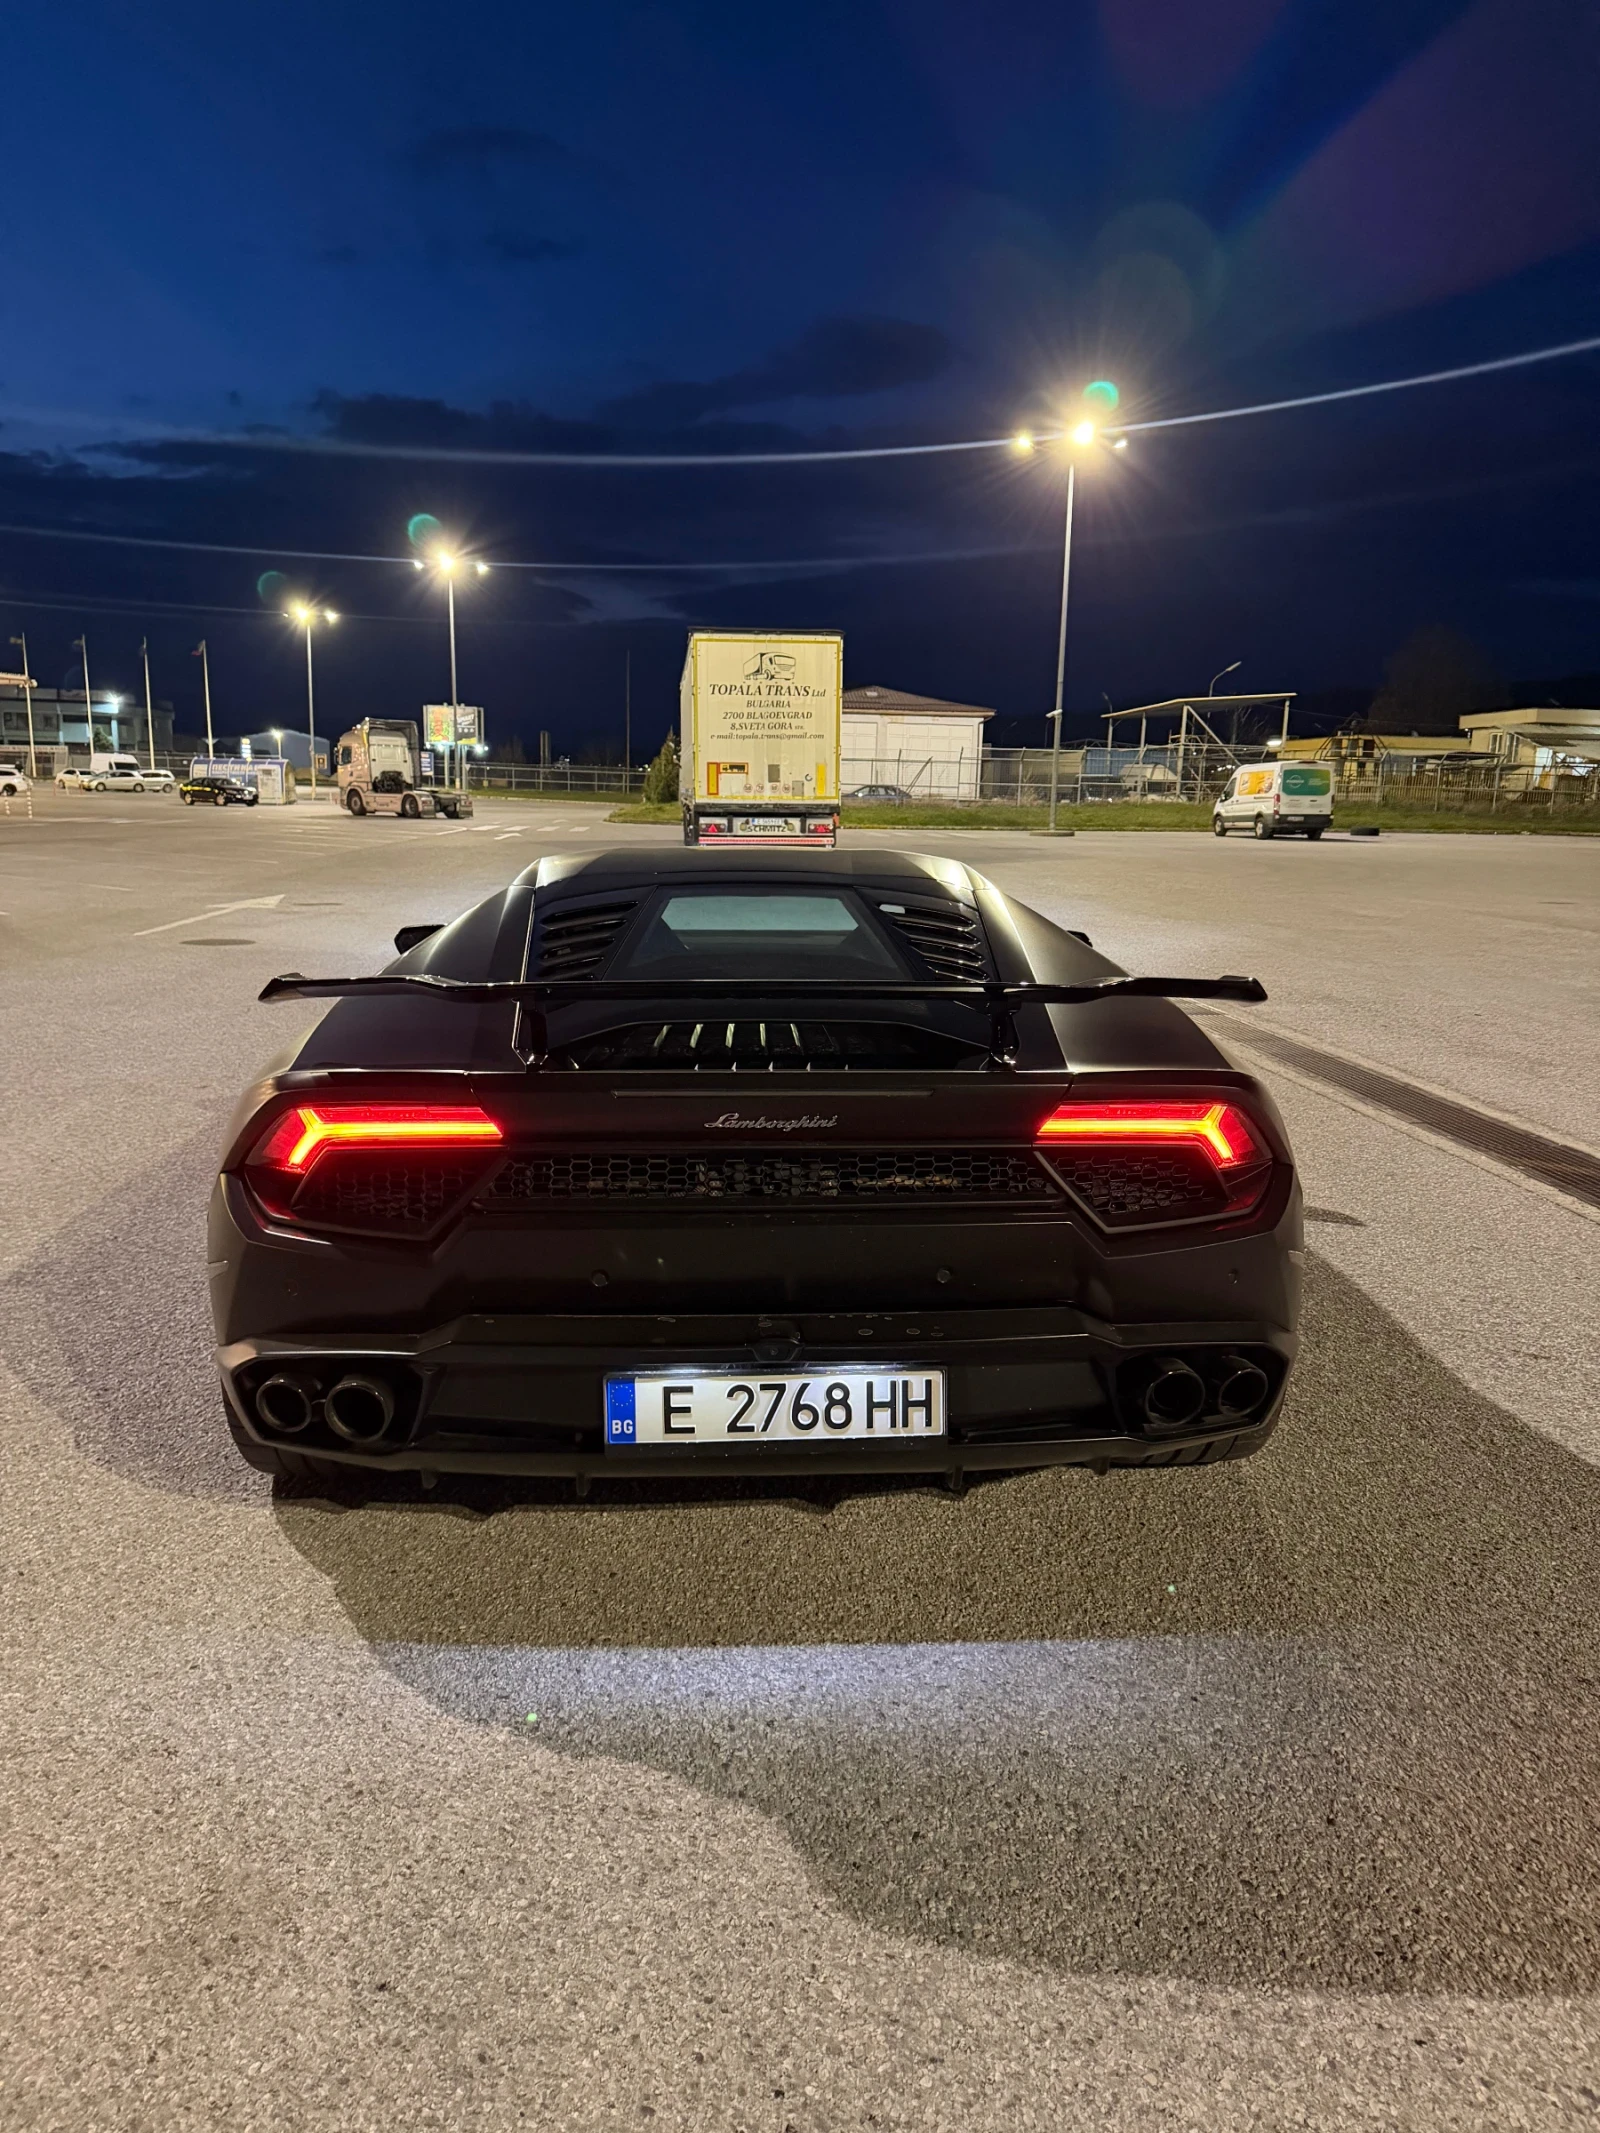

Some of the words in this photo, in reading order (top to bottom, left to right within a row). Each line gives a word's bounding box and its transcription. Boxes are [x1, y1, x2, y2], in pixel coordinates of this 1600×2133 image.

[709, 684, 762, 696] TOPALA
[765, 684, 811, 697] TRANS
[812, 689, 827, 697] Ltd
[746, 700, 791, 708] BULGARIA
[722, 711, 744, 720] 2700
[746, 711, 813, 720] BLAGOEVGRAD
[767, 722, 793, 730] GORA
[747, 824, 787, 833] SCHMITZ
[704, 1112, 838, 1132] Lamborghini
[663, 1385, 696, 1435] E
[726, 1381, 853, 1434] 2768
[866, 1378, 933, 1430] HH
[612, 1419, 634, 1435] BG
